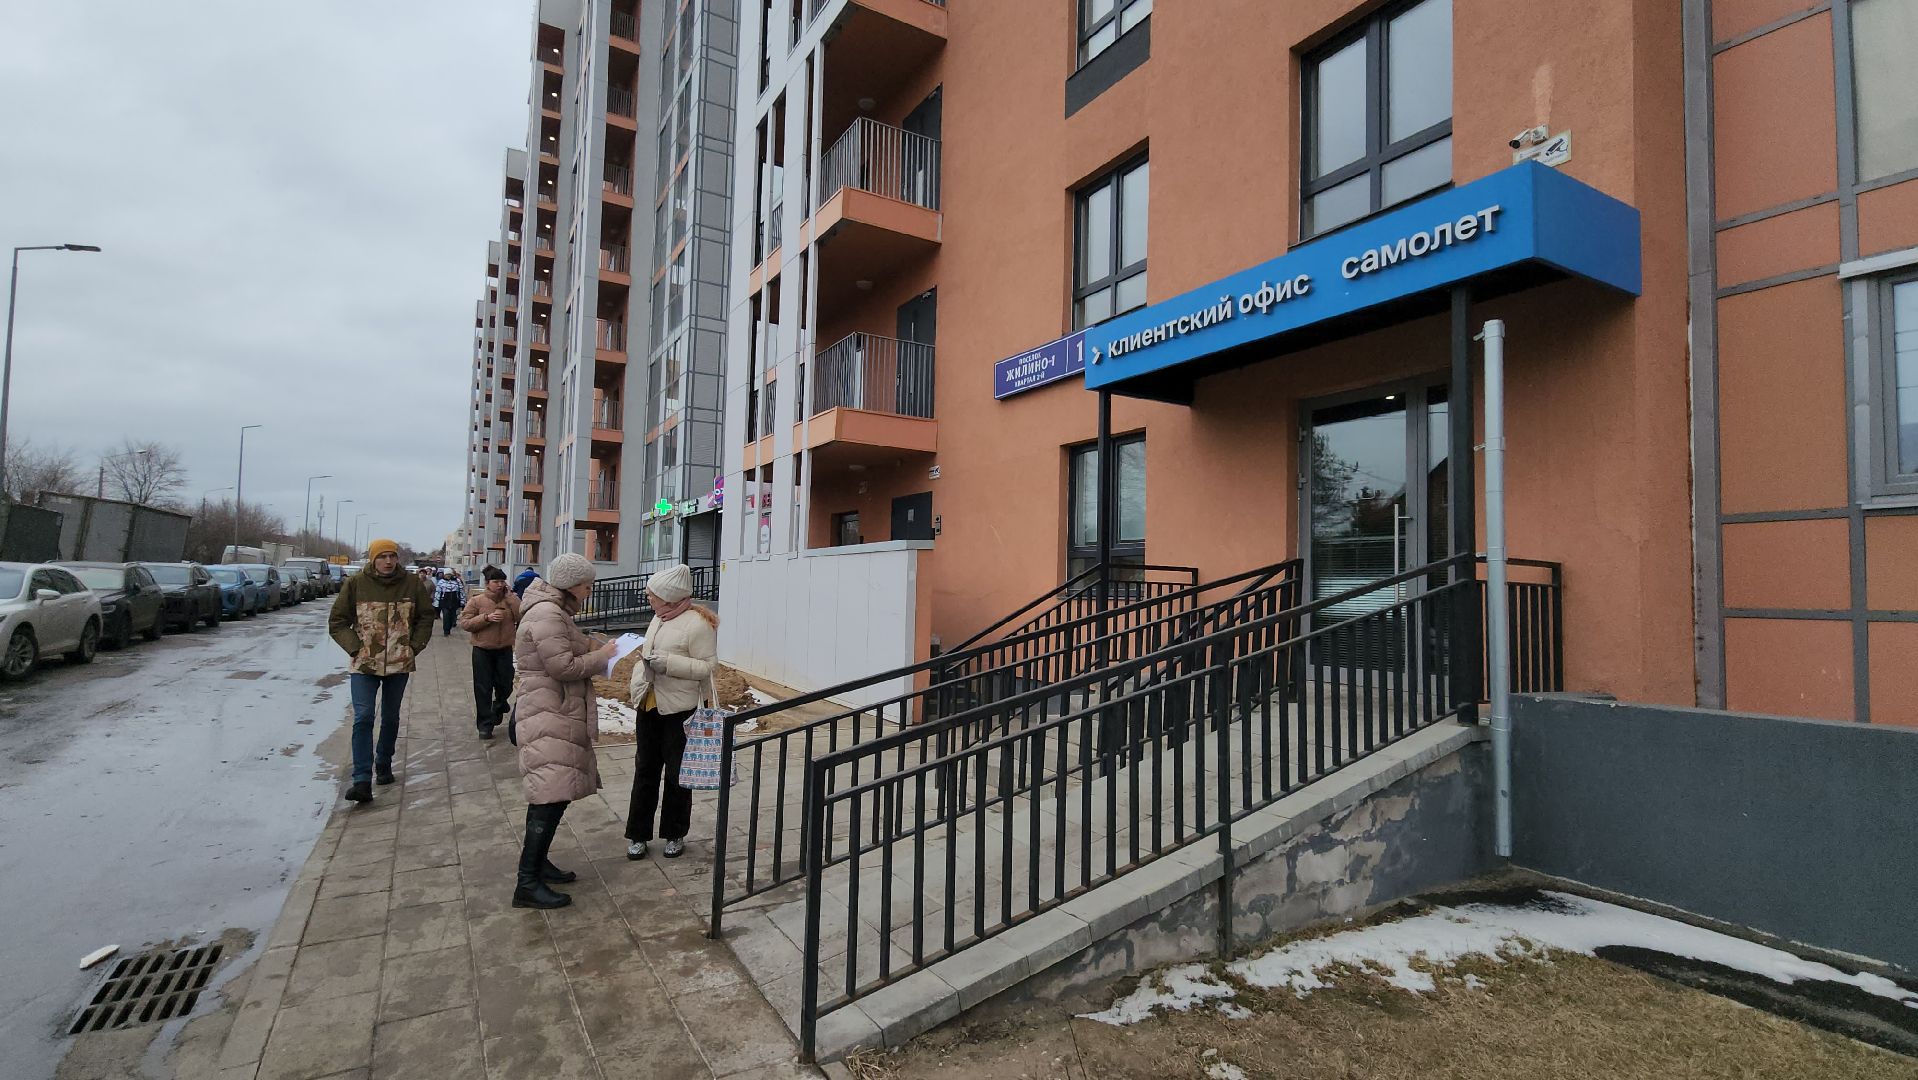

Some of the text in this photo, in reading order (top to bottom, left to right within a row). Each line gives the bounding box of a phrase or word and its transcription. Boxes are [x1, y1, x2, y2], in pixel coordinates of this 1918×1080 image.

[1341, 204, 1500, 279] самолет
[1108, 274, 1310, 358] клиентский офис
[1005, 355, 1056, 382] ЖИЛИНО-1
[1018, 351, 1042, 365] ПОСЕЛОК
